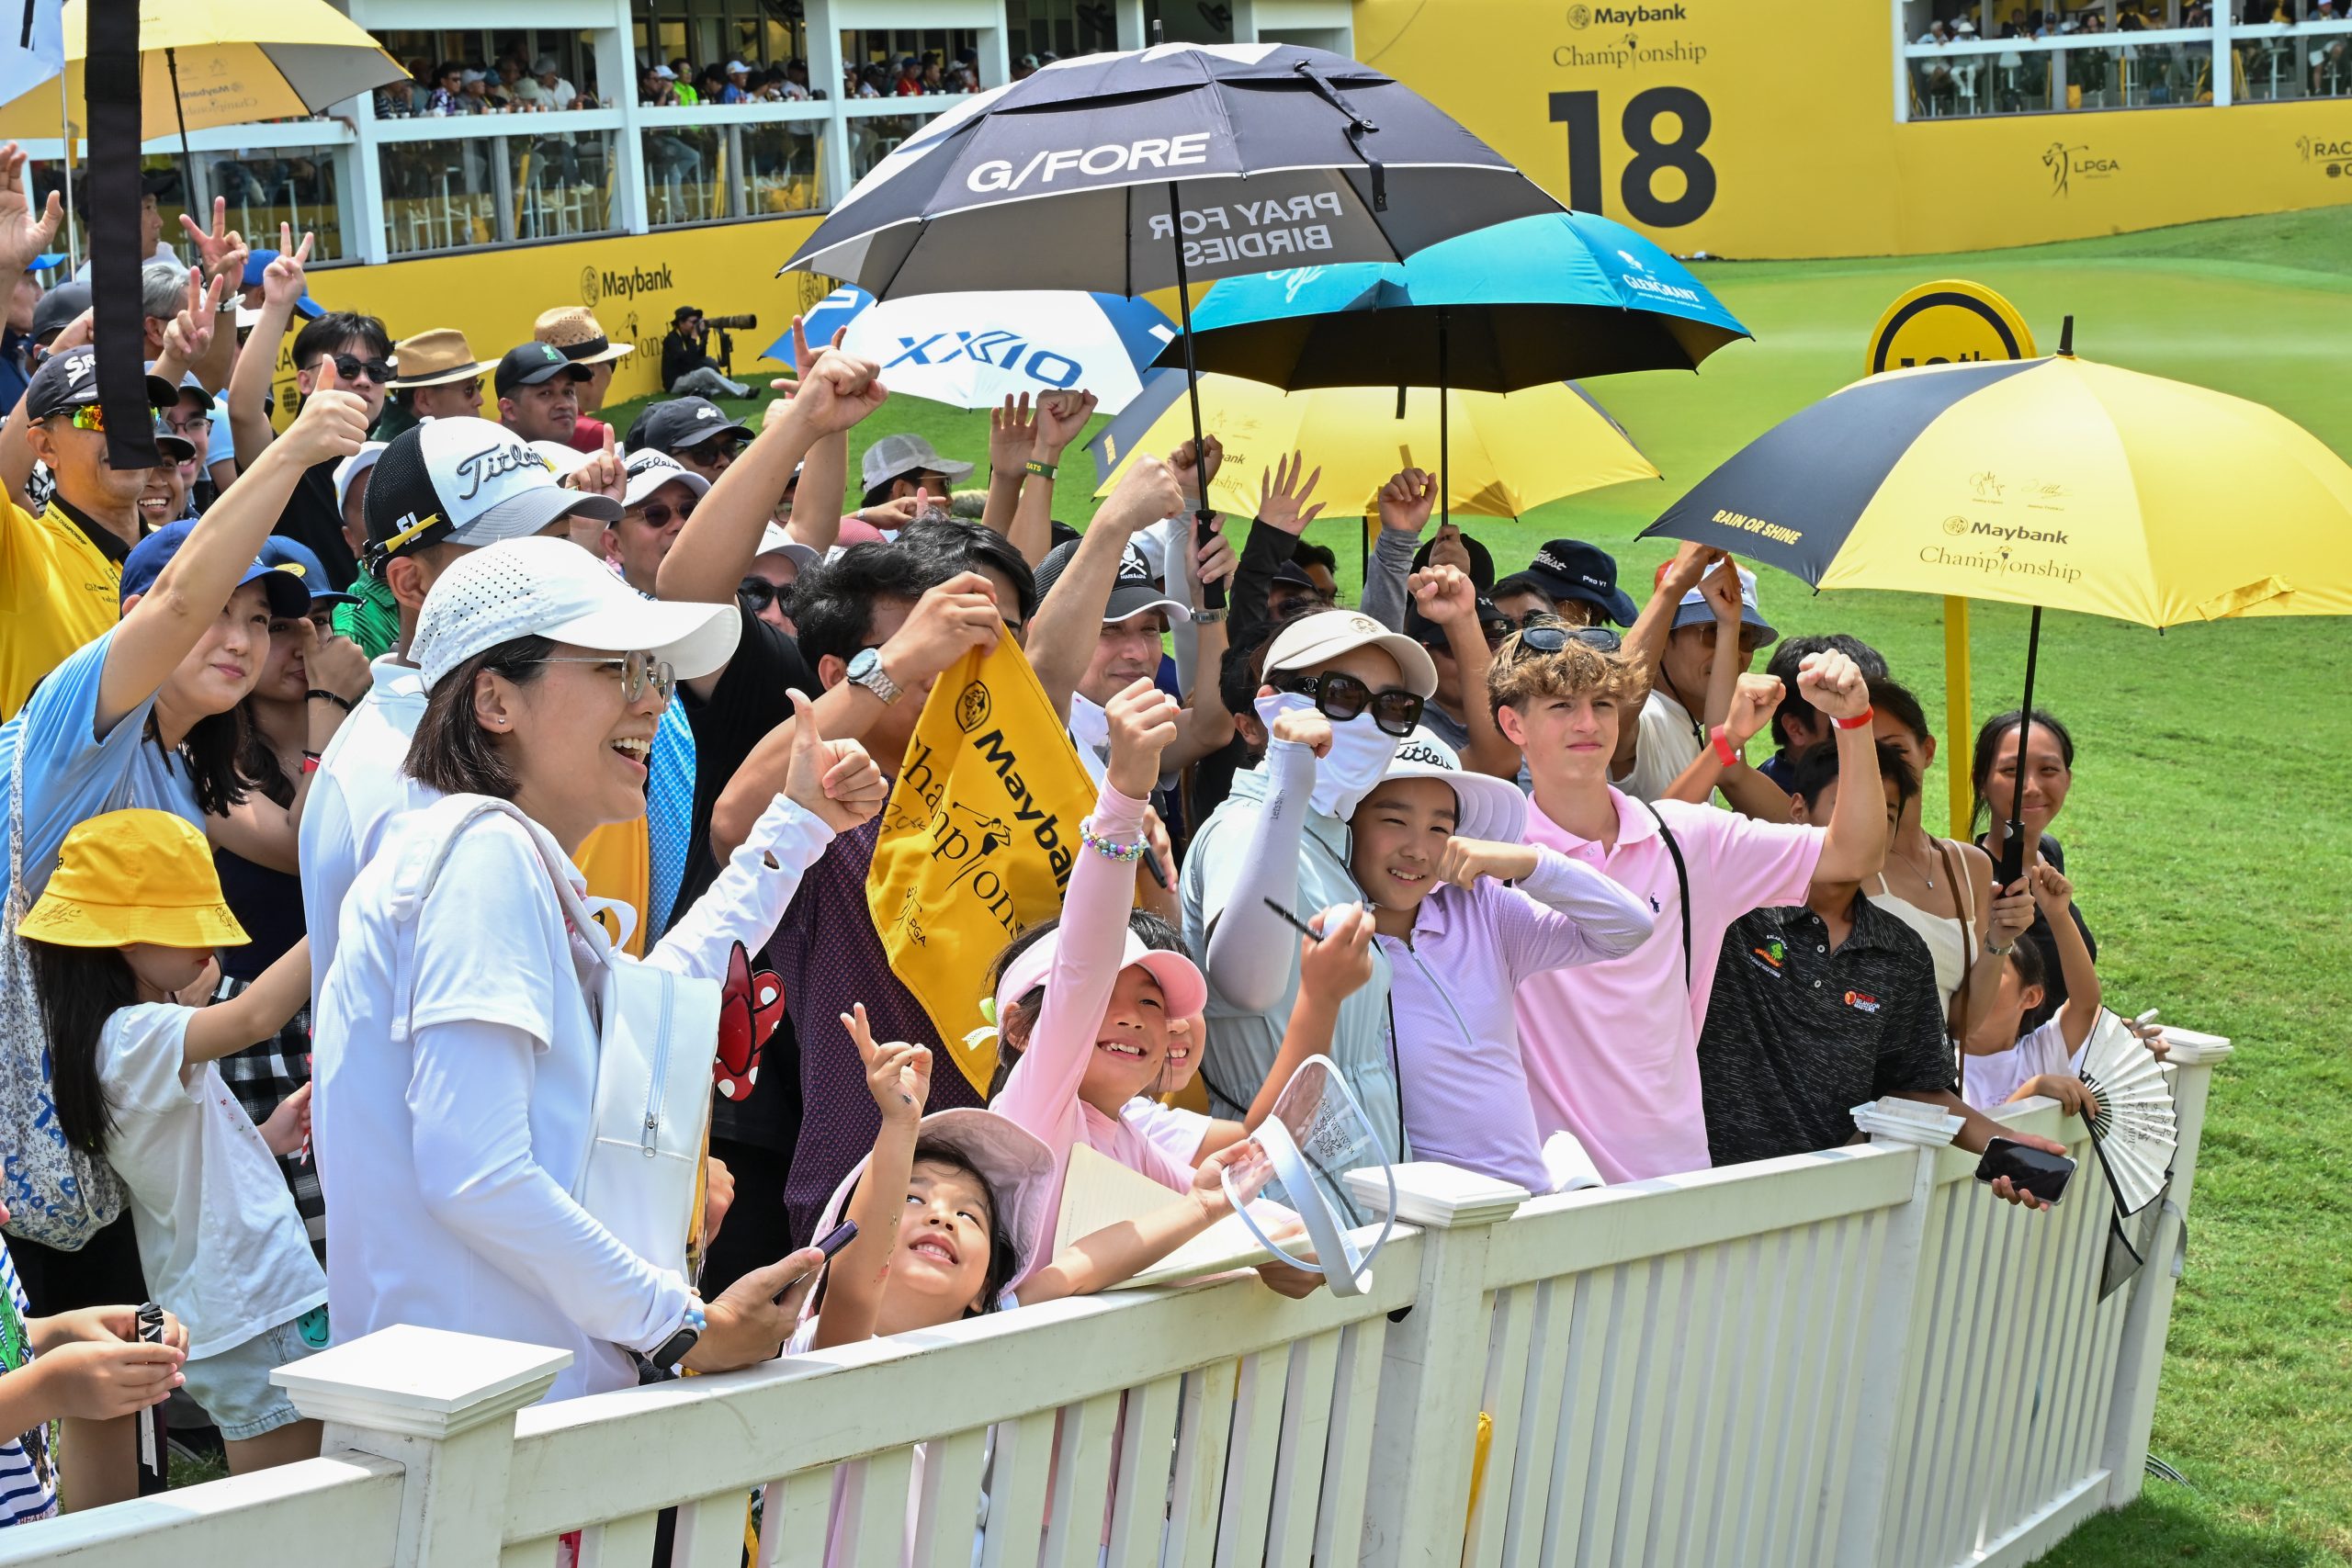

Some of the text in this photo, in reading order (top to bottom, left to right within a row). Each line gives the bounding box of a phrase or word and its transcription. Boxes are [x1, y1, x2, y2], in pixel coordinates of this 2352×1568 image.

[1594, 4, 1686, 26] Maybank
[1553, 39, 1707, 70] Championship
[967, 131, 1211, 193] G/FORE
[1548, 85, 1717, 229] 18
[2074, 159, 2120, 174] LPGA
[602, 262, 673, 301] Maybank
[1712, 509, 1803, 546] RAIN OR SHINE
[1970, 522, 2069, 545] Maybank
[1919, 546, 2083, 584] Championship
